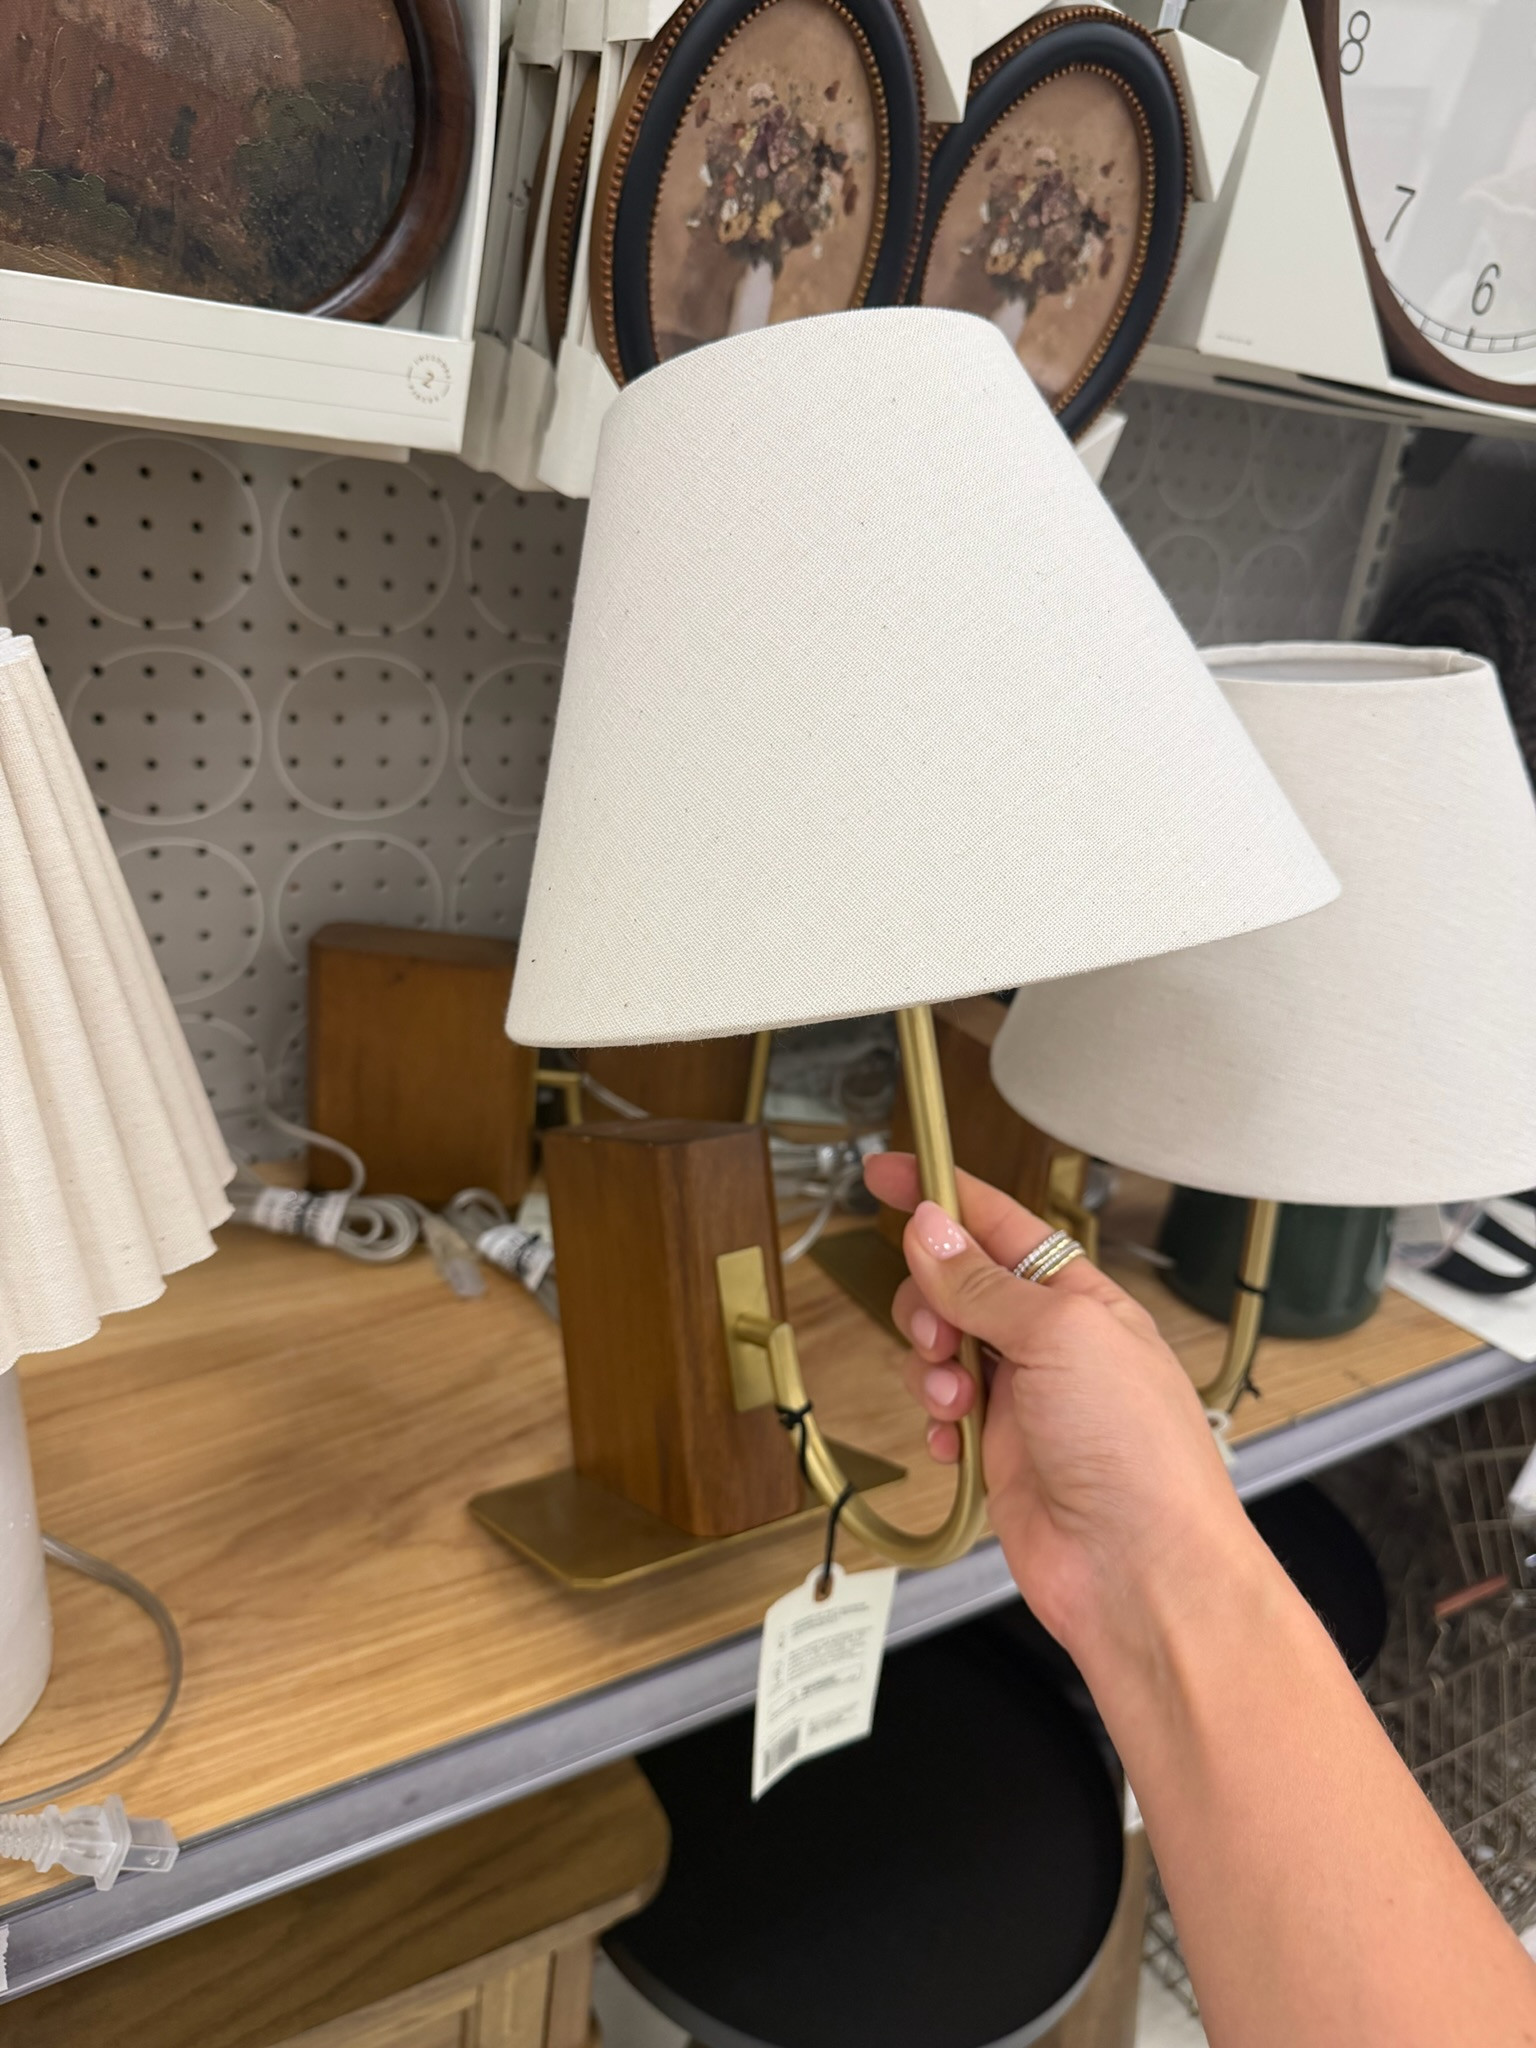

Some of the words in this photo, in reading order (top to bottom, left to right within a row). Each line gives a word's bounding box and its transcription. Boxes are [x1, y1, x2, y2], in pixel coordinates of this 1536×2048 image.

[1339, 10, 1371, 76] 8
[1385, 185, 1416, 243] 7
[1471, 262, 1502, 317] 6
[421, 370, 435, 389] 2
